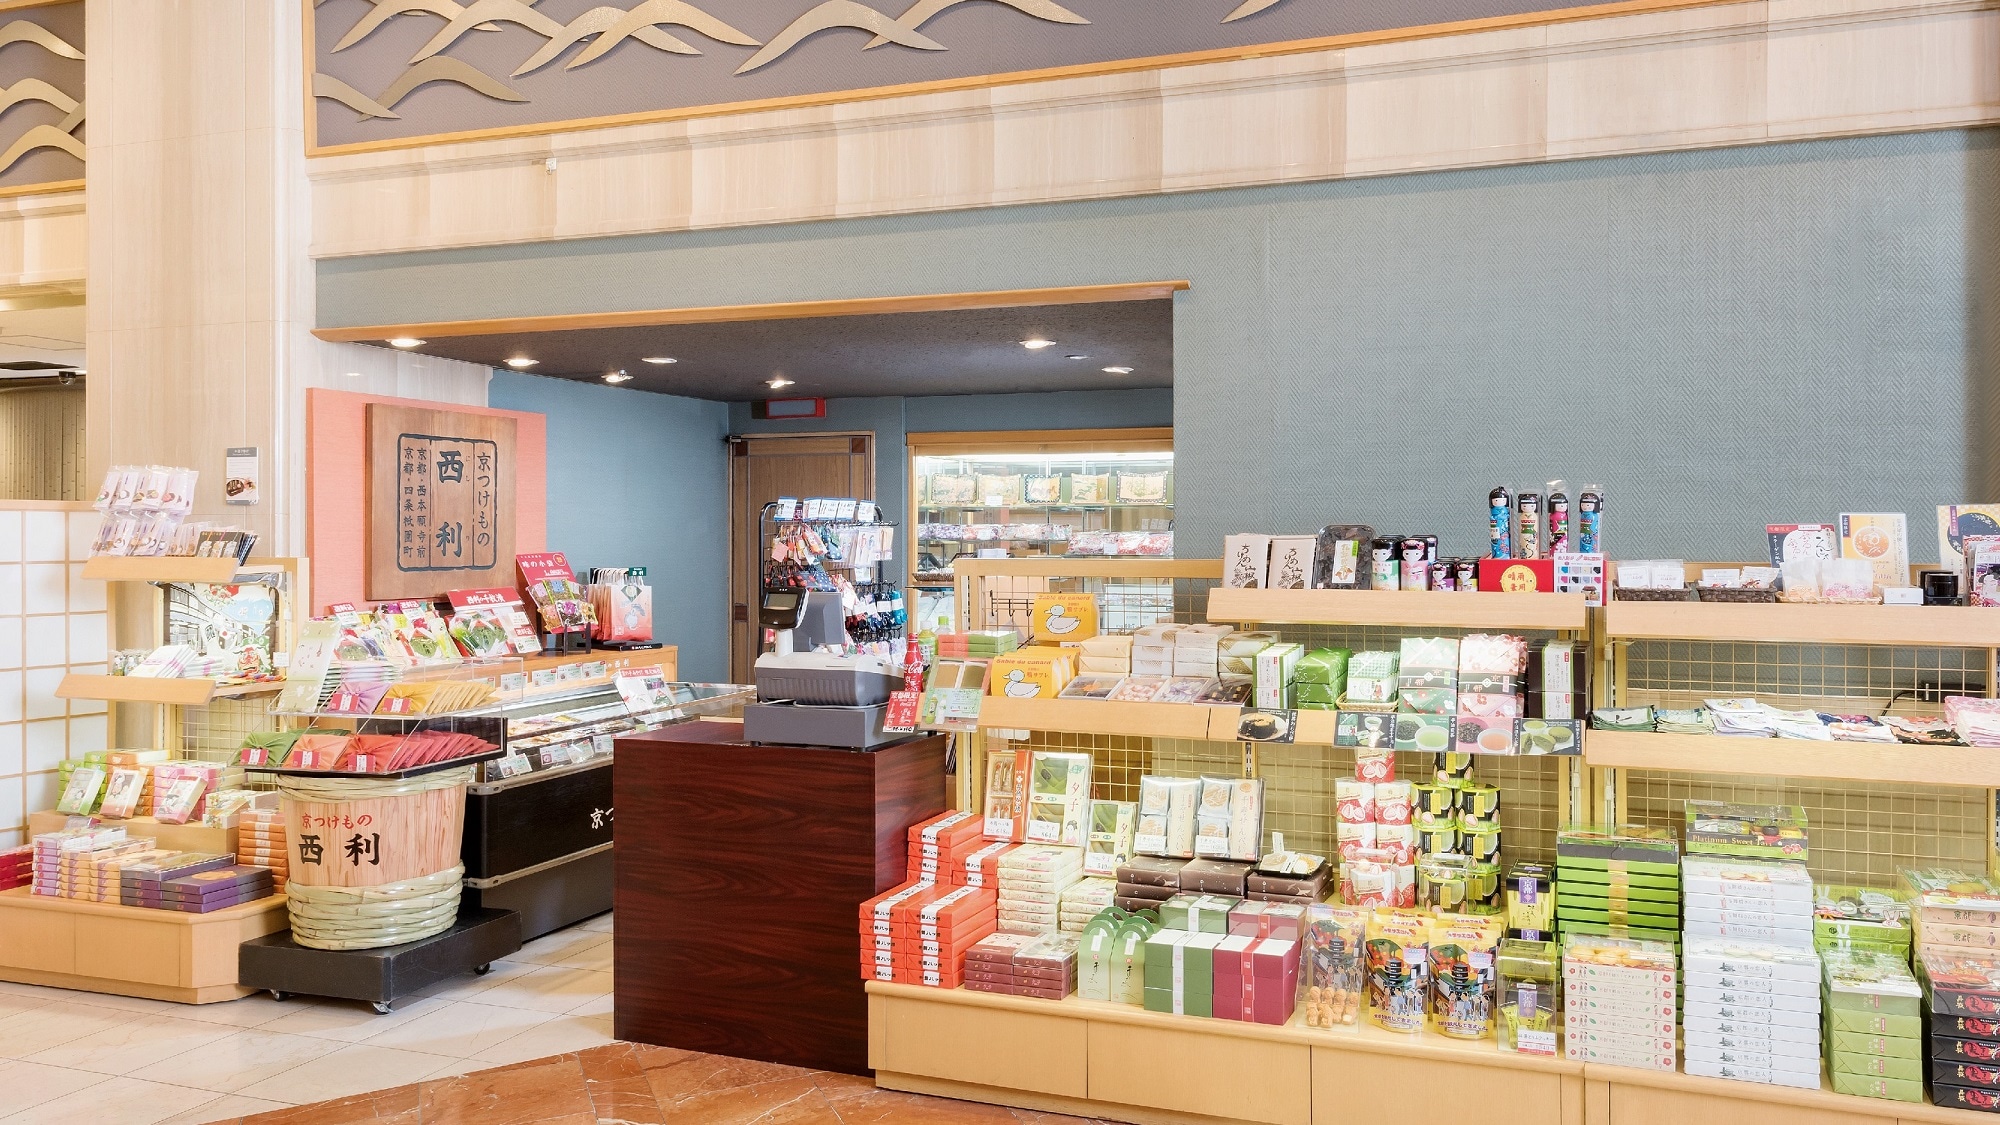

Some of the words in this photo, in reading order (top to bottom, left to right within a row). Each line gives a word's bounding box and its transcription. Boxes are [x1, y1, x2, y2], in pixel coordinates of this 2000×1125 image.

[416, 448, 427, 558] 京都・西本願寺前
[435, 450, 465, 558] 西利
[476, 452, 492, 547] 京つけもの
[302, 813, 373, 830] 京つけもの
[298, 832, 381, 867] 西利
[1692, 834, 1727, 844] Platinum
[1732, 837, 1753, 846] Sweet
[1523, 880, 1533, 894] 京都
